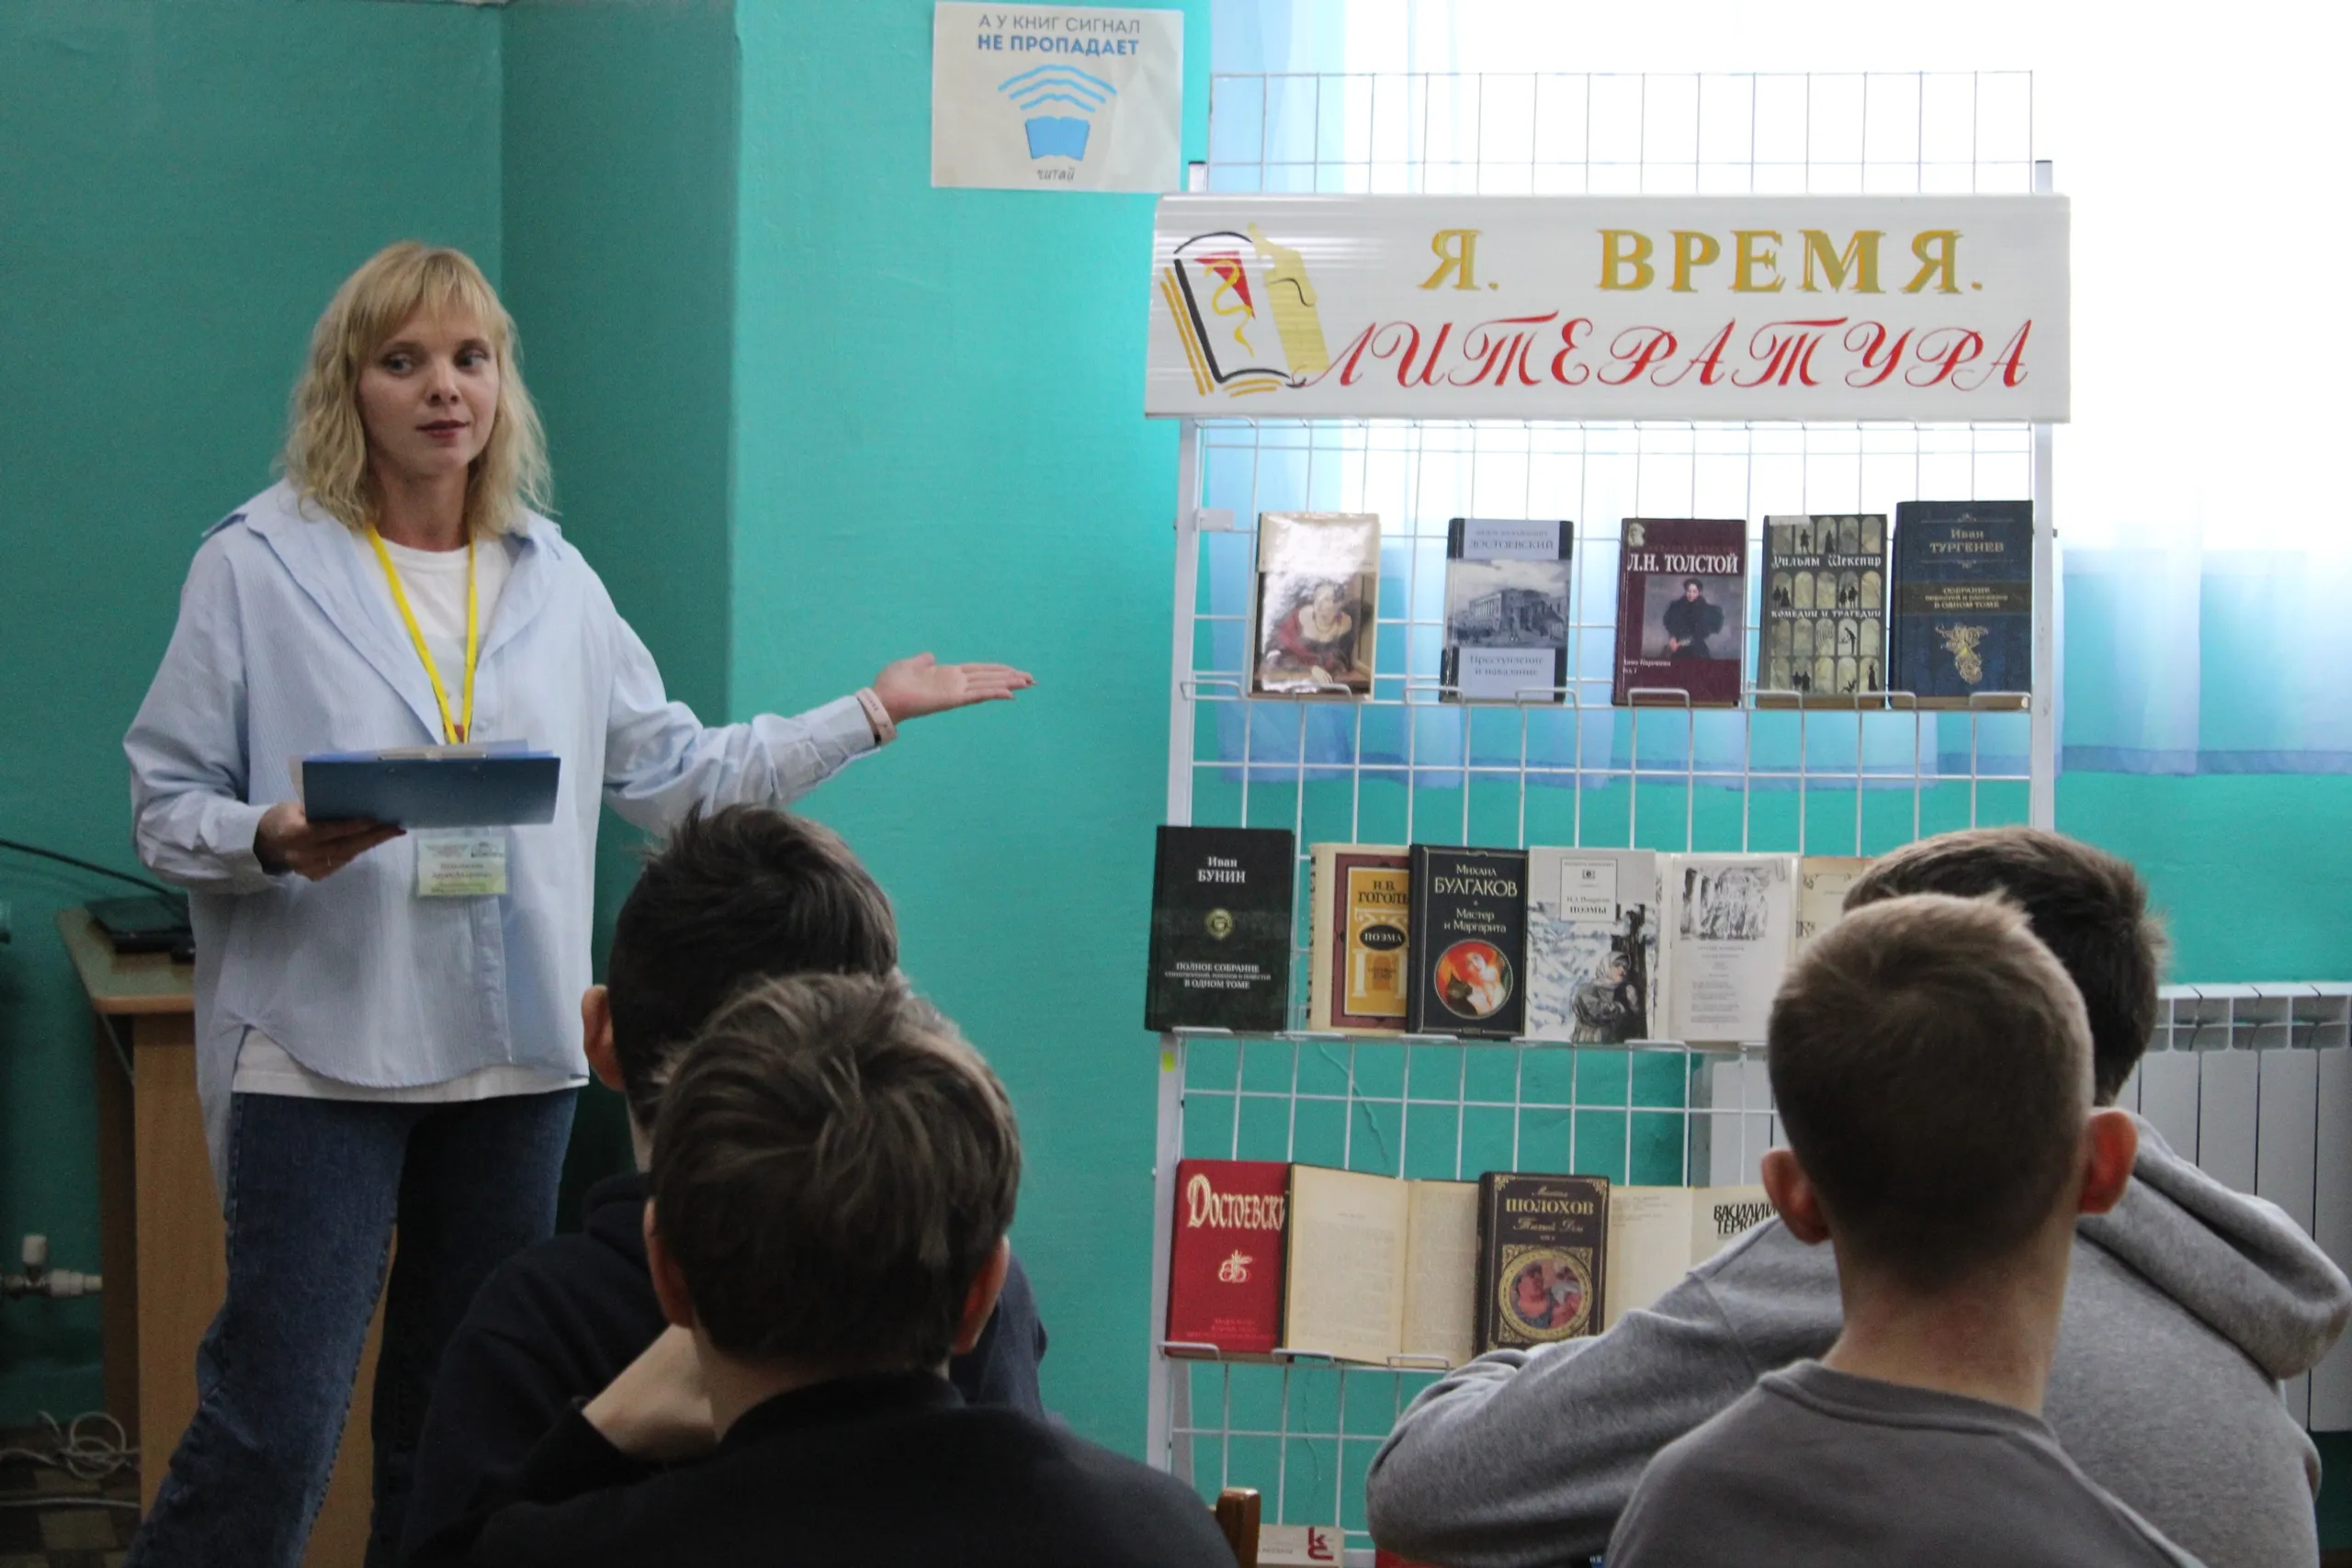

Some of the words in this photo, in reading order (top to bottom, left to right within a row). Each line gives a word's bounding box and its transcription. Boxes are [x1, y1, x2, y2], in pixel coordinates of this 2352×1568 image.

[978, 15, 991, 28] А
[996, 16, 1008, 29] У
[1013, 16, 1060, 30] КНИГ
[1066, 17, 1140, 34] СИГНАЛ
[978, 35, 1003, 51] НЕ
[1011, 36, 1139, 56] ПРОПАДАЕТ
[1037, 167, 1075, 181] читай
[1419, 228, 1499, 290] Я.
[1594, 228, 1984, 295] ВРЕМЯ.
[1292, 310, 2033, 392] ЛИТЕРАТУРА
[1928, 542, 2005, 553] ТУРГЕНЕВ
[1627, 553, 1659, 571] Л.Н.
[1665, 553, 1738, 573] ТОЛСТОЙ
[1207, 856, 1238, 867] Иван
[1197, 869, 1247, 884] БУНИН
[1435, 876, 1519, 897] БУЛГАКОВ
[1456, 908, 1496, 922] Мастер
[1443, 922, 1452, 931] и
[1453, 919, 1507, 935] Маргарита
[1363, 932, 1403, 942] ПОЭМА
[1176, 962, 1212, 972] ПОЛНОЕ
[1214, 964, 1261, 974] СОБРАНИЕ
[1226, 980, 1250, 989] ТОМЕ
[1187, 1173, 1284, 1231] ДОСТОЕВСКИ
[1505, 1198, 1594, 1215] ШОЛОХОВ
